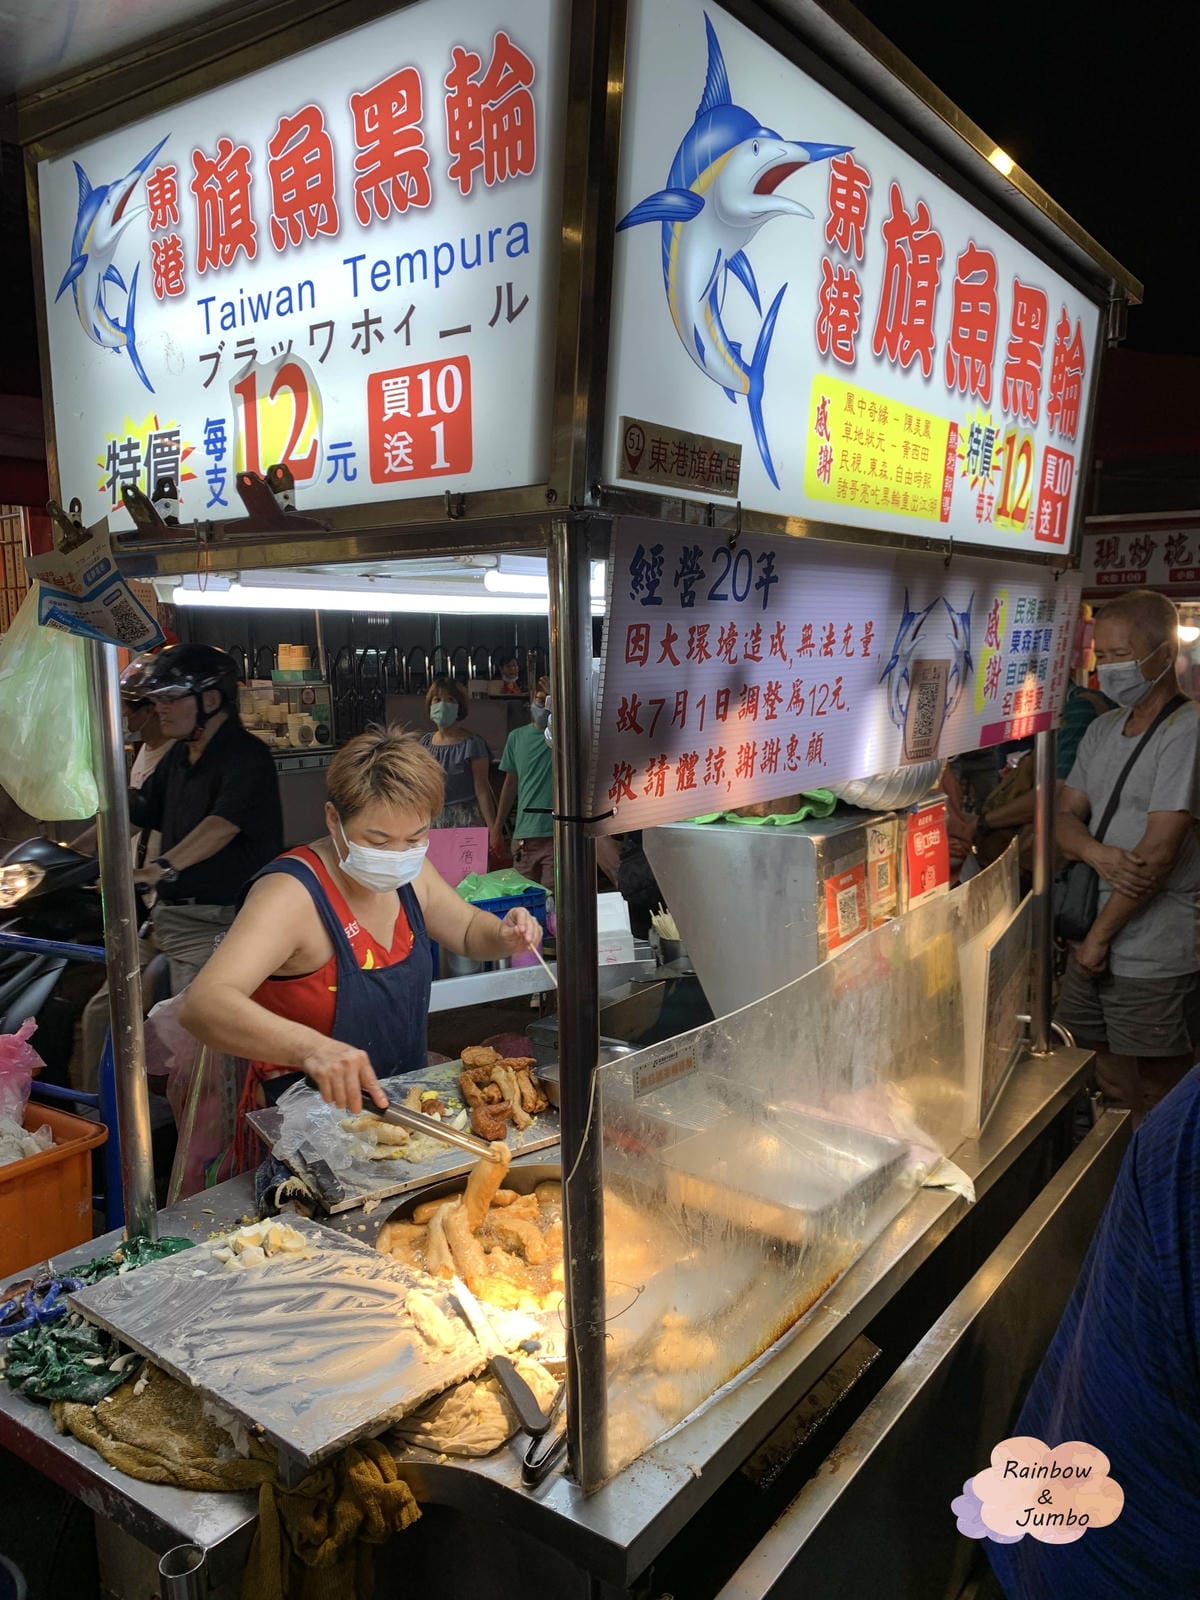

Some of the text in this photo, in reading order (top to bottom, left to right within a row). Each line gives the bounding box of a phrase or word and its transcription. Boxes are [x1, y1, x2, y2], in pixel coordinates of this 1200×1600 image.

[191, 31, 536, 274] 旗魚黑輪
[147, 163, 186, 300] 東港
[816, 152, 872, 365] 東港
[197, 221, 530, 335] Taiwan Tempura
[873, 183, 1085, 442] 旗魚黑輪
[105, 430, 181, 505] 特價
[203, 417, 229, 508] 每支
[628, 432, 641, 451] 51
[648, 437, 740, 486] 東港旗魚串
[815, 395, 834, 484] 感謝
[966, 421, 995, 478] 特價
[997, 433, 1032, 523] 12
[629, 543, 779, 610] 經營20年
[1093, 532, 1200, 571] 現炒花
[984, 598, 1003, 700] 感謝
